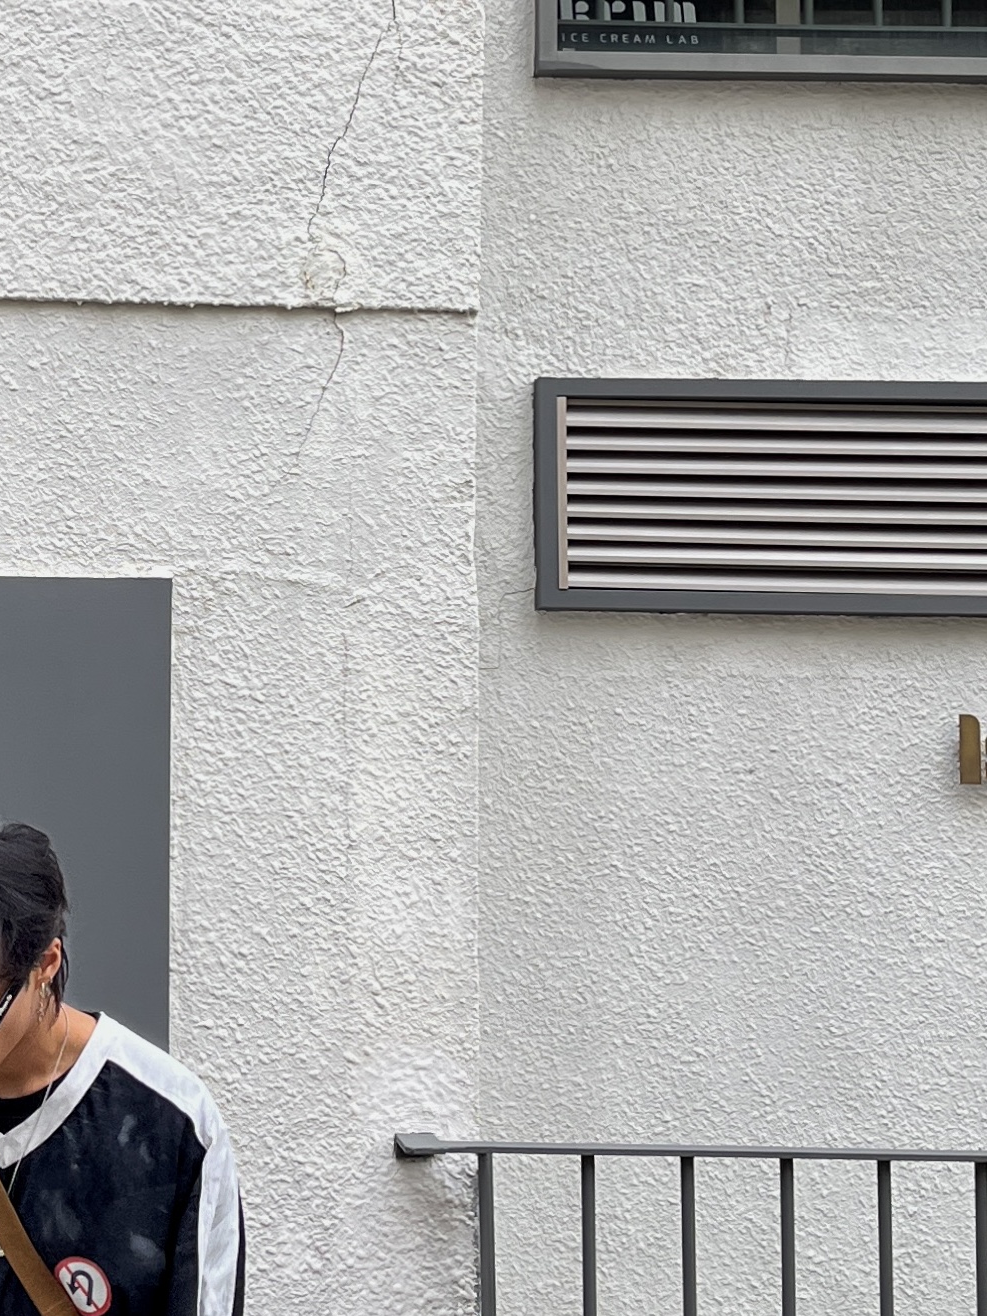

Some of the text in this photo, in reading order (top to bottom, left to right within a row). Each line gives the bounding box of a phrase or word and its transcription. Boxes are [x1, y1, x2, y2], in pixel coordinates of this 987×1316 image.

[561, 33, 699, 45] ICE CREAM LAB
